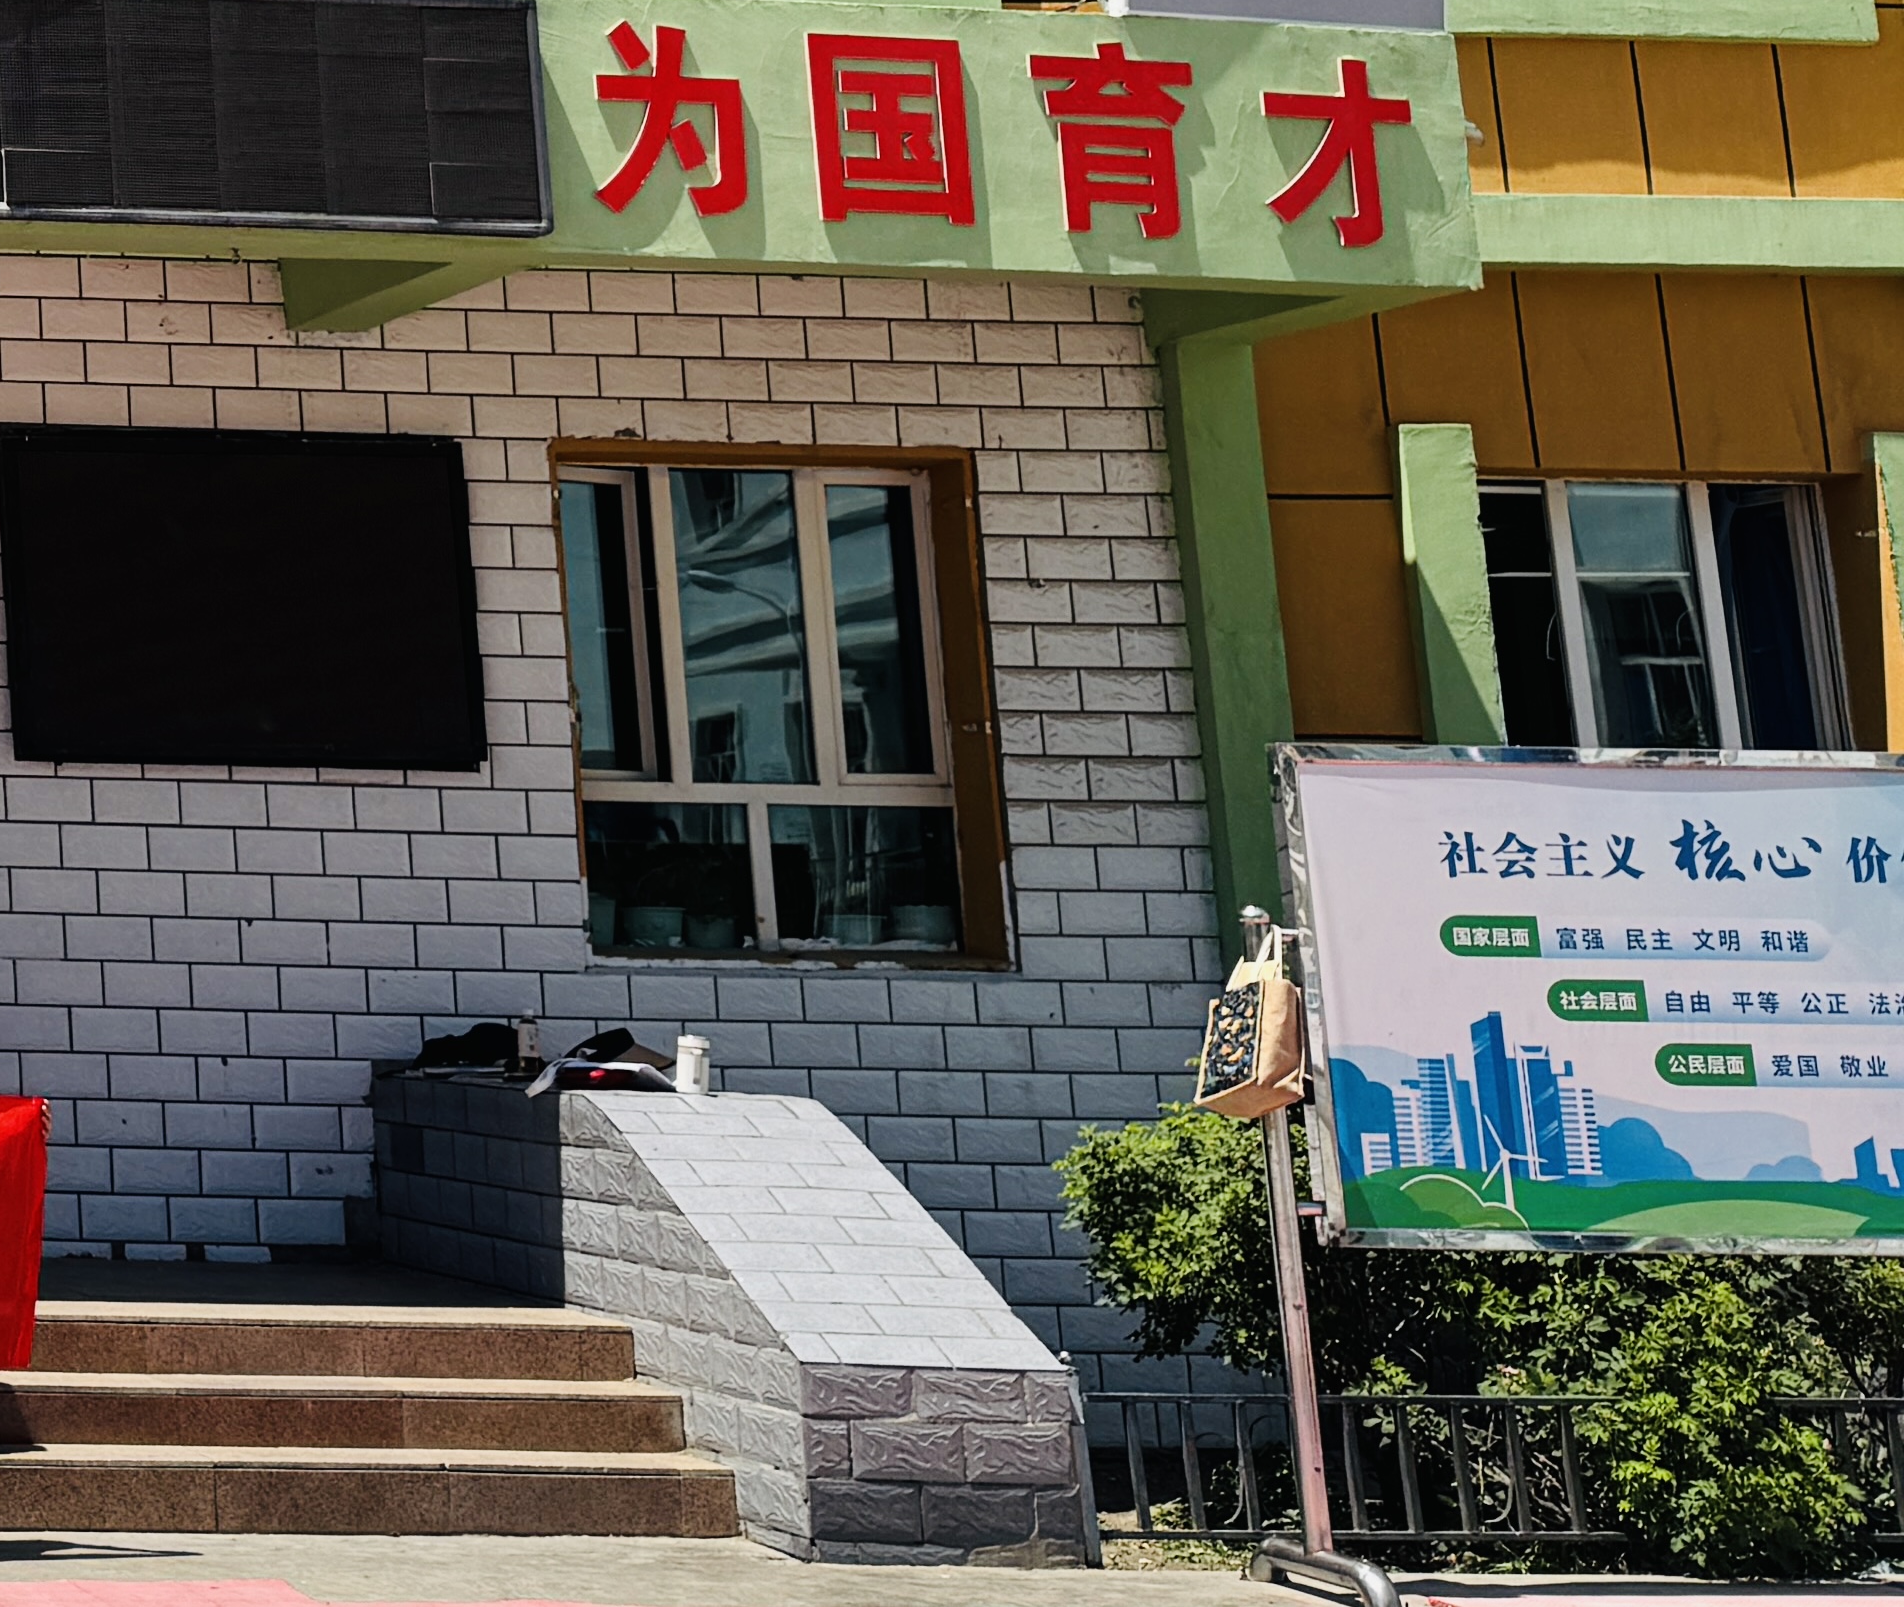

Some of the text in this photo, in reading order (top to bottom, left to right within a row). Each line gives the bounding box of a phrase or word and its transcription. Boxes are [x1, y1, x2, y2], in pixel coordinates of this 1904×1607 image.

[594, 19, 1412, 248] 为国育才
[1438, 819, 1904, 883] 社会主义 核心 价
[1452, 925, 1810, 953] 国家层面 富强 民主 文明 和谐
[1559, 990, 1638, 1012] 社会层面
[1665, 991, 1712, 1014] 自由
[1732, 991, 1781, 1014] 平等
[1800, 992, 1850, 1015] 公正
[1669, 1054, 1889, 1078] 公民层面 爱国 敬业
